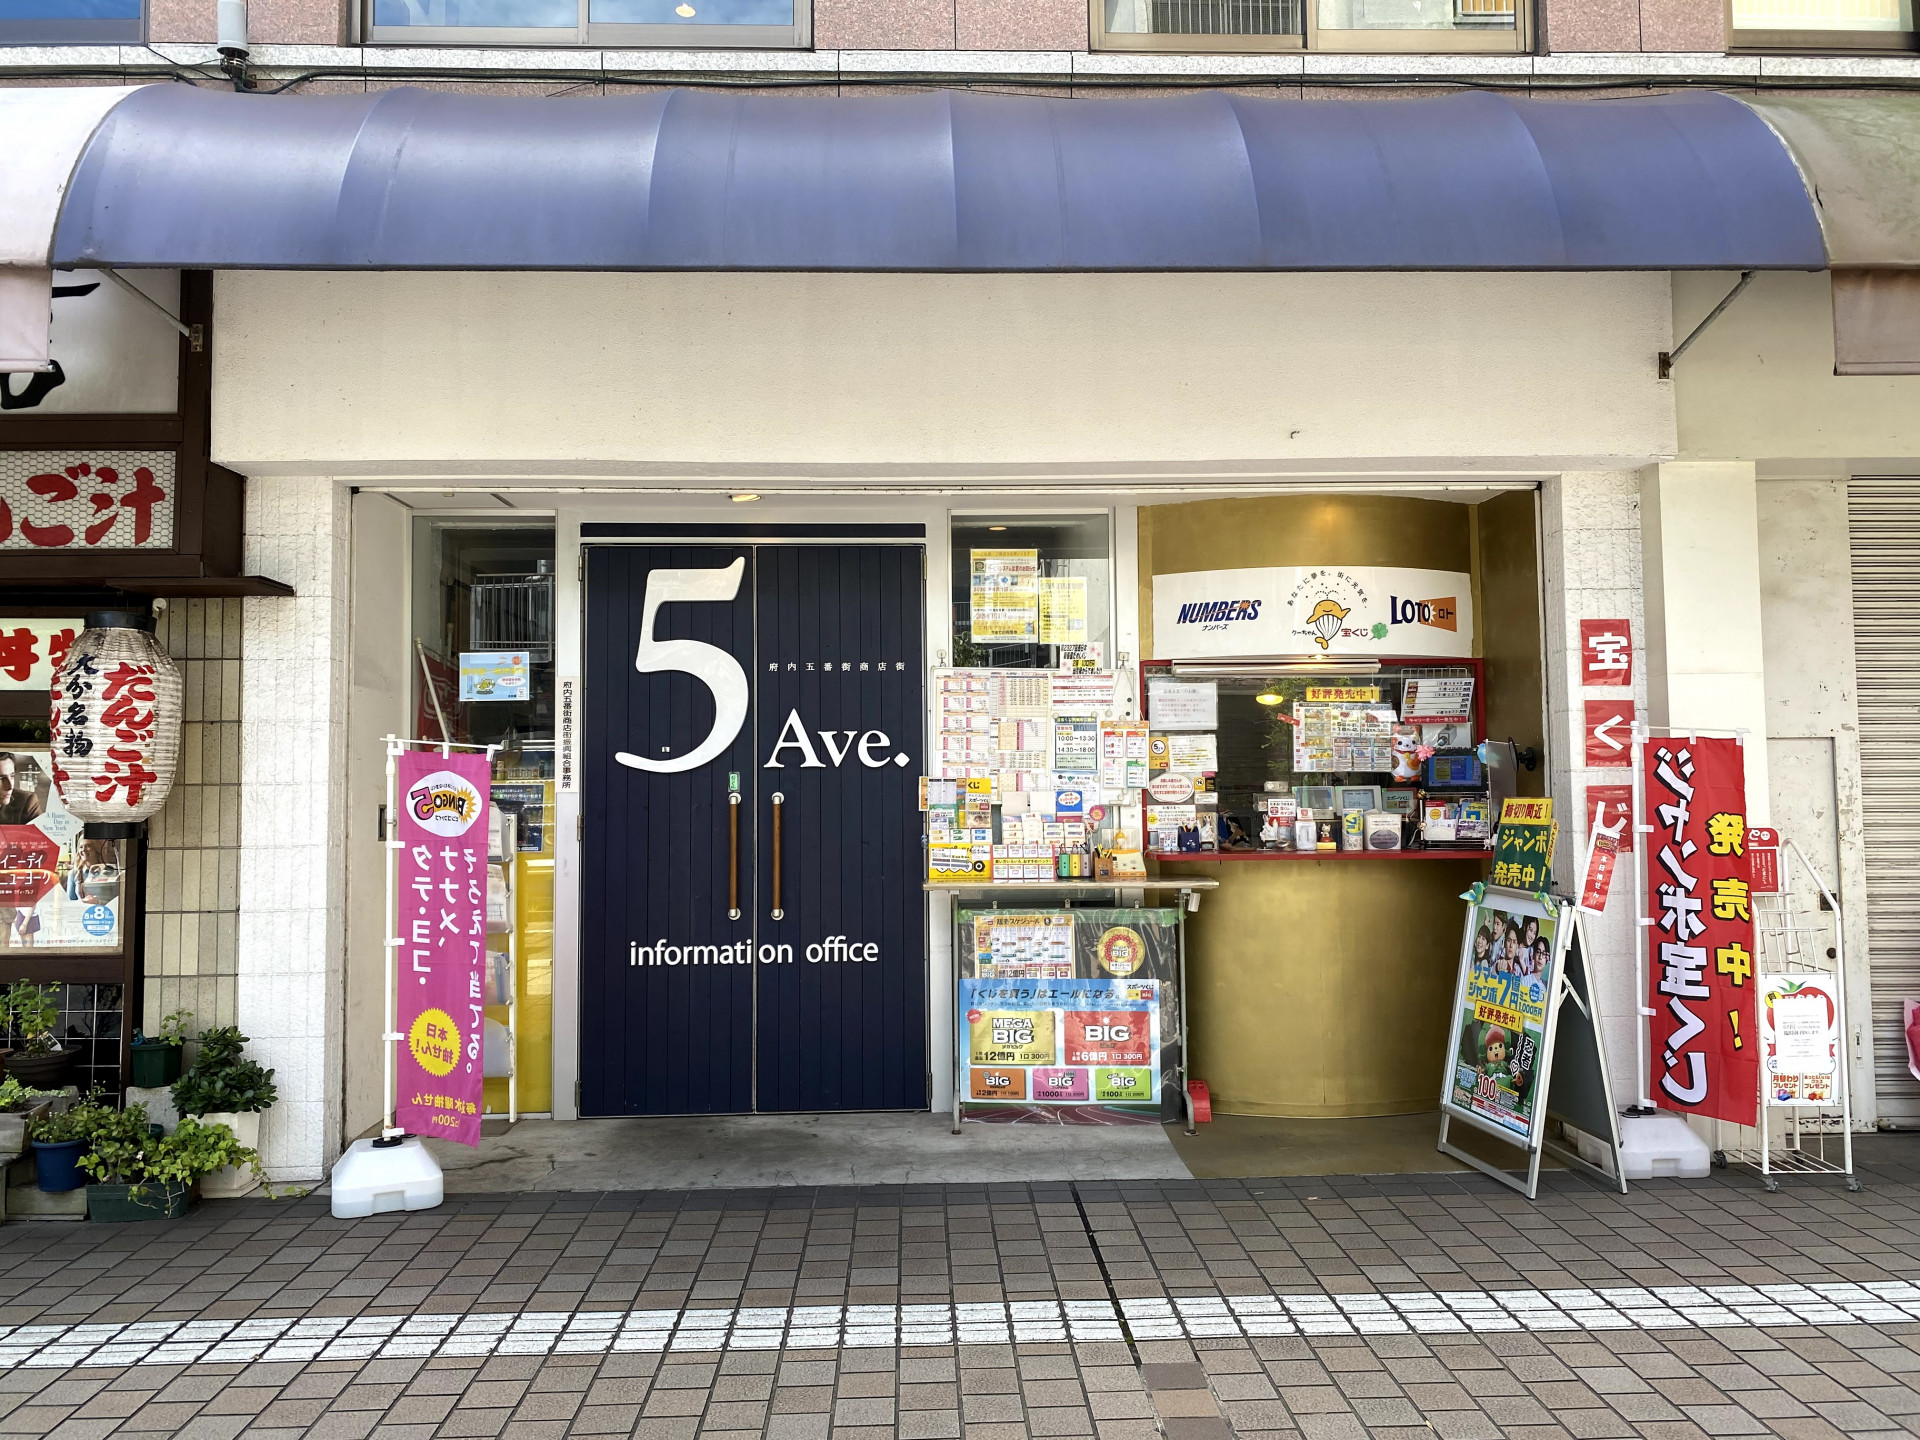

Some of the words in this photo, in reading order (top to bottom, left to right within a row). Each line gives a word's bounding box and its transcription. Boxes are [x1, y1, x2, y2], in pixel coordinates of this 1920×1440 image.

[0, 462, 166, 547] ご汁
[1176, 600, 1262, 625] NUMBERS
[1390, 595, 1431, 625] LOTO
[1201, 623, 1230, 631] ナンバーズ
[1341, 628, 1369, 637] 宝くじ
[614, 556, 749, 773] 5
[763, 708, 910, 768] Ave.
[768, 662, 906, 672] 府内五番街商店街
[1311, 688, 1374, 700] 好評発売中!
[63, 653, 101, 758] 大分名物
[91, 662, 158, 807] だんご汁
[1504, 803, 1549, 820] 締切り間近!
[1502, 829, 1548, 853] ジャンボ
[1493, 861, 1547, 889] 発売中!
[630, 939, 793, 967] information
[805, 935, 879, 963] office
[1474, 964, 1498, 983] サマー
[970, 987, 1121, 1000] 「くじを買う」はエールになる。
[1468, 981, 1498, 1003] ジャンボ
[1497, 969, 1512, 1006] 7
[992, 1018, 1033, 1028] MEGA
[1479, 1005, 1521, 1028] 好評発売中!
[992, 1029, 1035, 1044] BIG
[1085, 1024, 1130, 1042] BIG
[984, 1052, 1015, 1061] 12億円
[1081, 1052, 1107, 1061] 6億円
[985, 1075, 1011, 1086] BIG
[1048, 1075, 1073, 1086] BIG
[1111, 1075, 1136, 1087] BIG
[1478, 1074, 1497, 1100] 100
